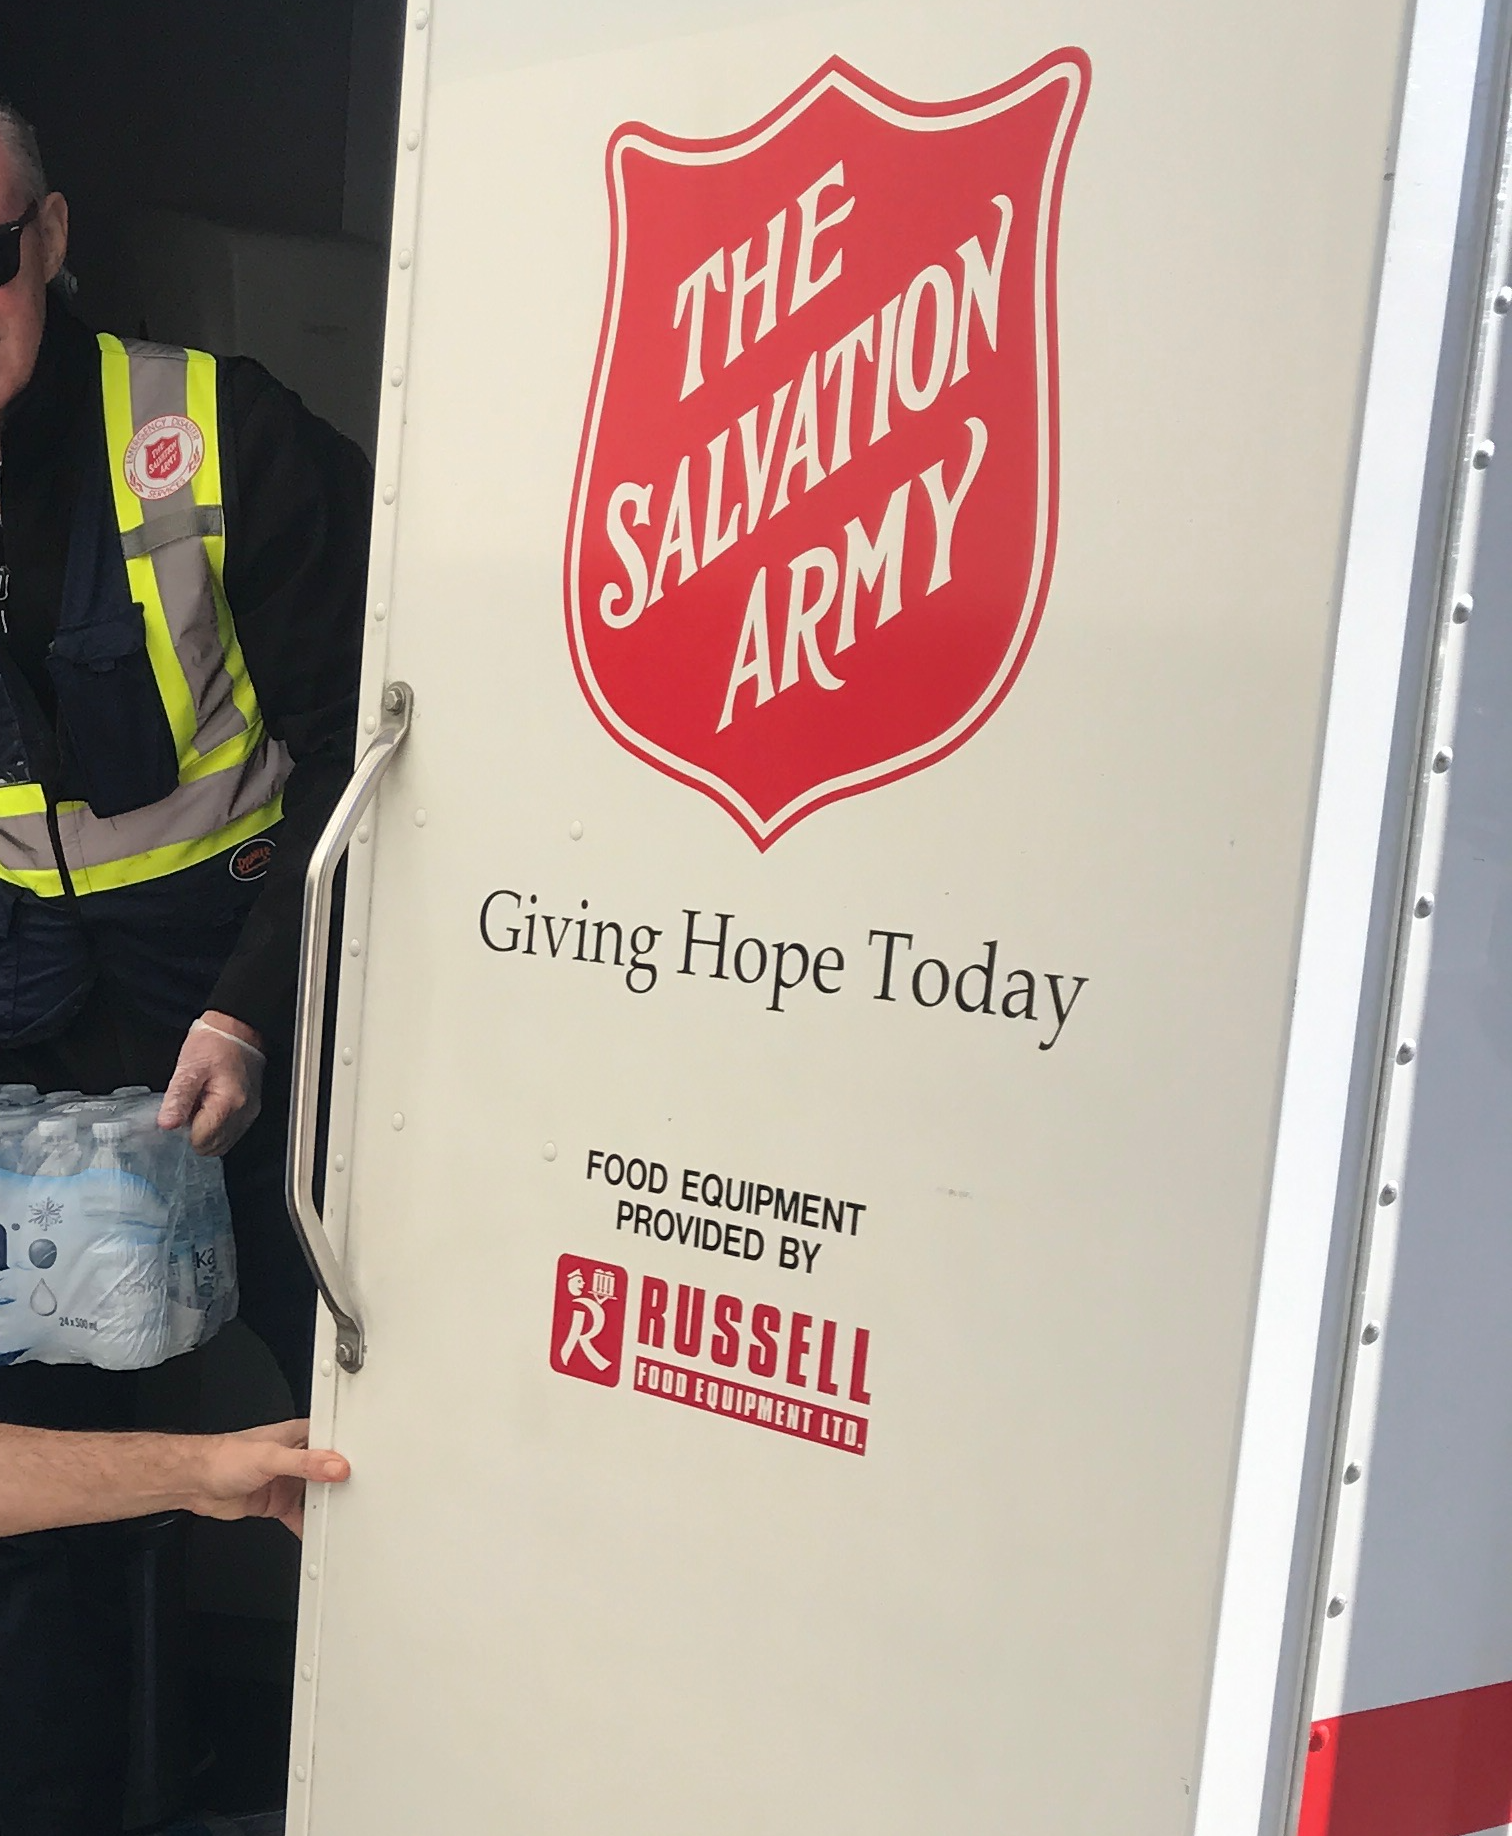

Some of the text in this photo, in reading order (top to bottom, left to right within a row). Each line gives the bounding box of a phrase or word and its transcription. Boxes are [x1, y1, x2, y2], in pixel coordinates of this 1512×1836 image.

[672, 159, 856, 402] THE
[599, 194, 1013, 630] SALVATION
[714, 416, 989, 734] ARMY
[478, 889, 1090, 1051] Giving Hope Today
[586, 1149, 868, 1237] FOOD EQUIPMENT
[615, 1200, 822, 1275] PROVIDED BY
[637, 1274, 872, 1406] RUSSELL
[637, 1361, 864, 1450] FOOD EQUIPMENT LTD.
